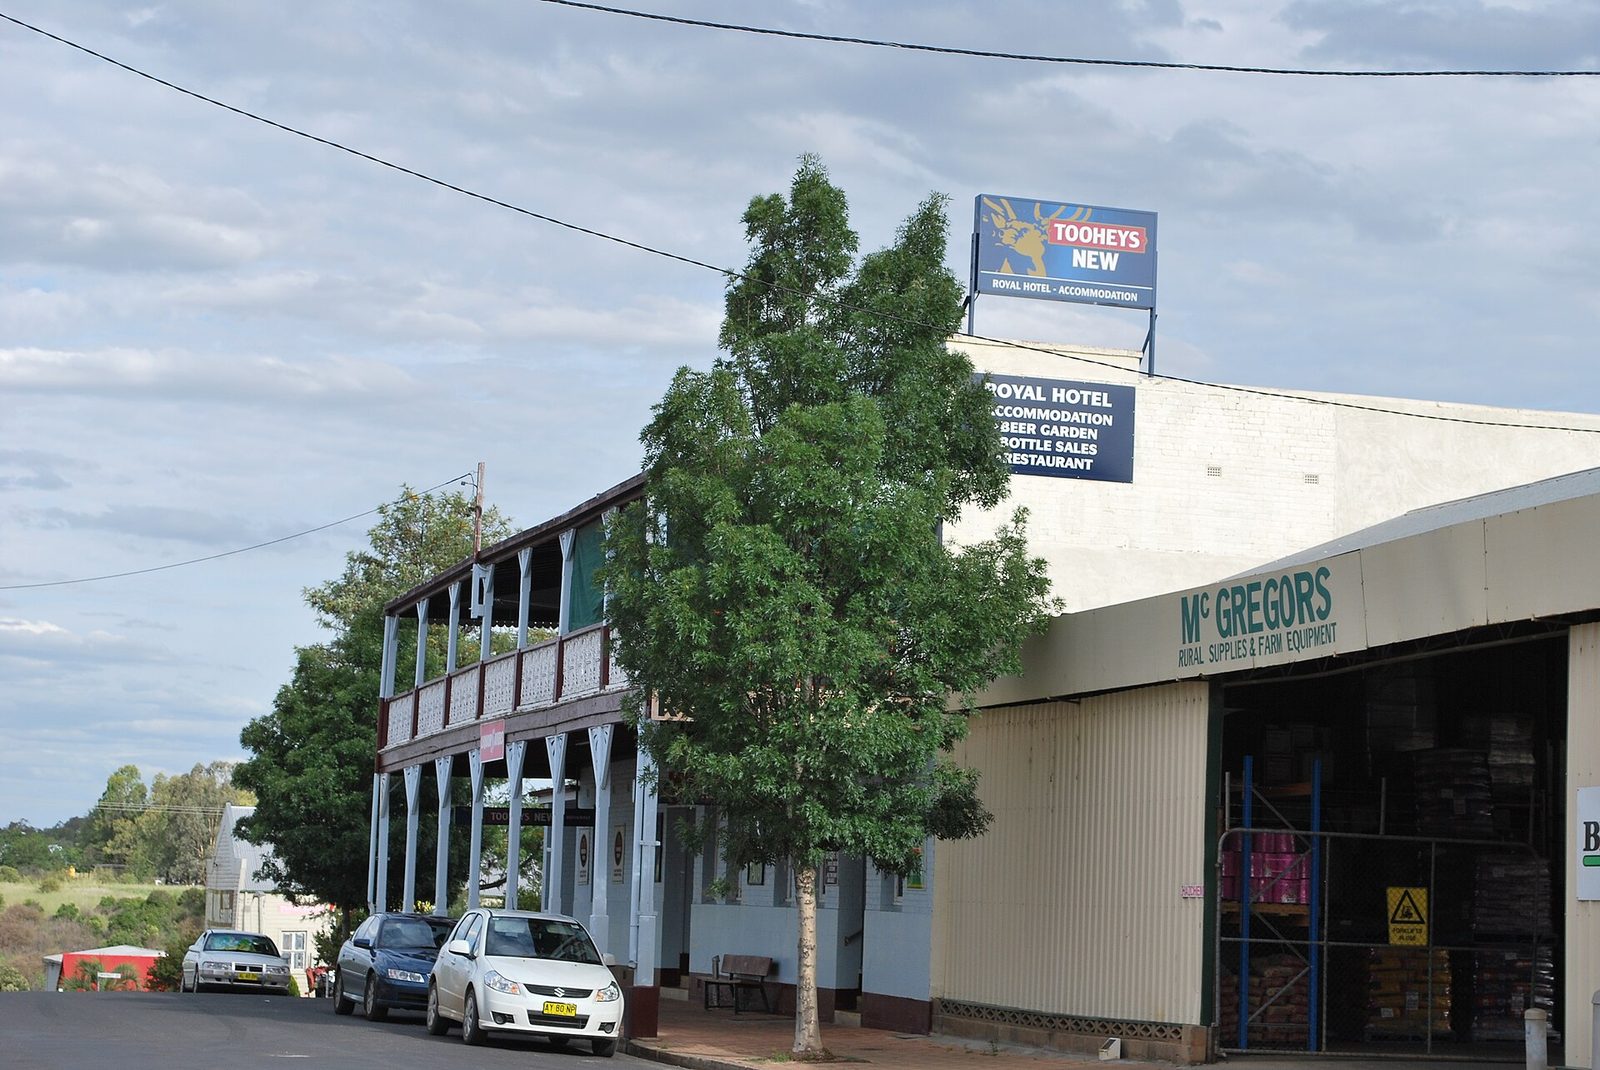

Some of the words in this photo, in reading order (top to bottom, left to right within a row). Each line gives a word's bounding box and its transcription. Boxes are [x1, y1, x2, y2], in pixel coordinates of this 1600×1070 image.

[1054, 223, 1140, 248] TOOHEYS
[1072, 248, 1119, 271] NEW
[992, 279, 1021, 290] ROYAL
[1023, 282, 1051, 293] HOTEL
[1058, 285, 1138, 301] ACCOMMODATION
[984, 382, 1046, 401] ROYAL
[1052, 387, 1112, 407] HOTEL
[1000, 421, 1036, 435] BEER
[1040, 424, 1098, 440] GARDEN
[1000, 437, 1052, 451] BOTTLE
[1055, 440, 1098, 455] SALES
[1003, 452, 1093, 470] RESTAURANT
[1216, 566, 1332, 639] GREGORS
[1178, 646, 1204, 667] RURAL
[1209, 638, 1248, 663] SUPPLIES
[1250, 637, 1256, 656] &
[1258, 632, 1283, 656] FARM
[1287, 622, 1337, 653] EQUIPMENT
[490, 811, 530, 822] TOOS
